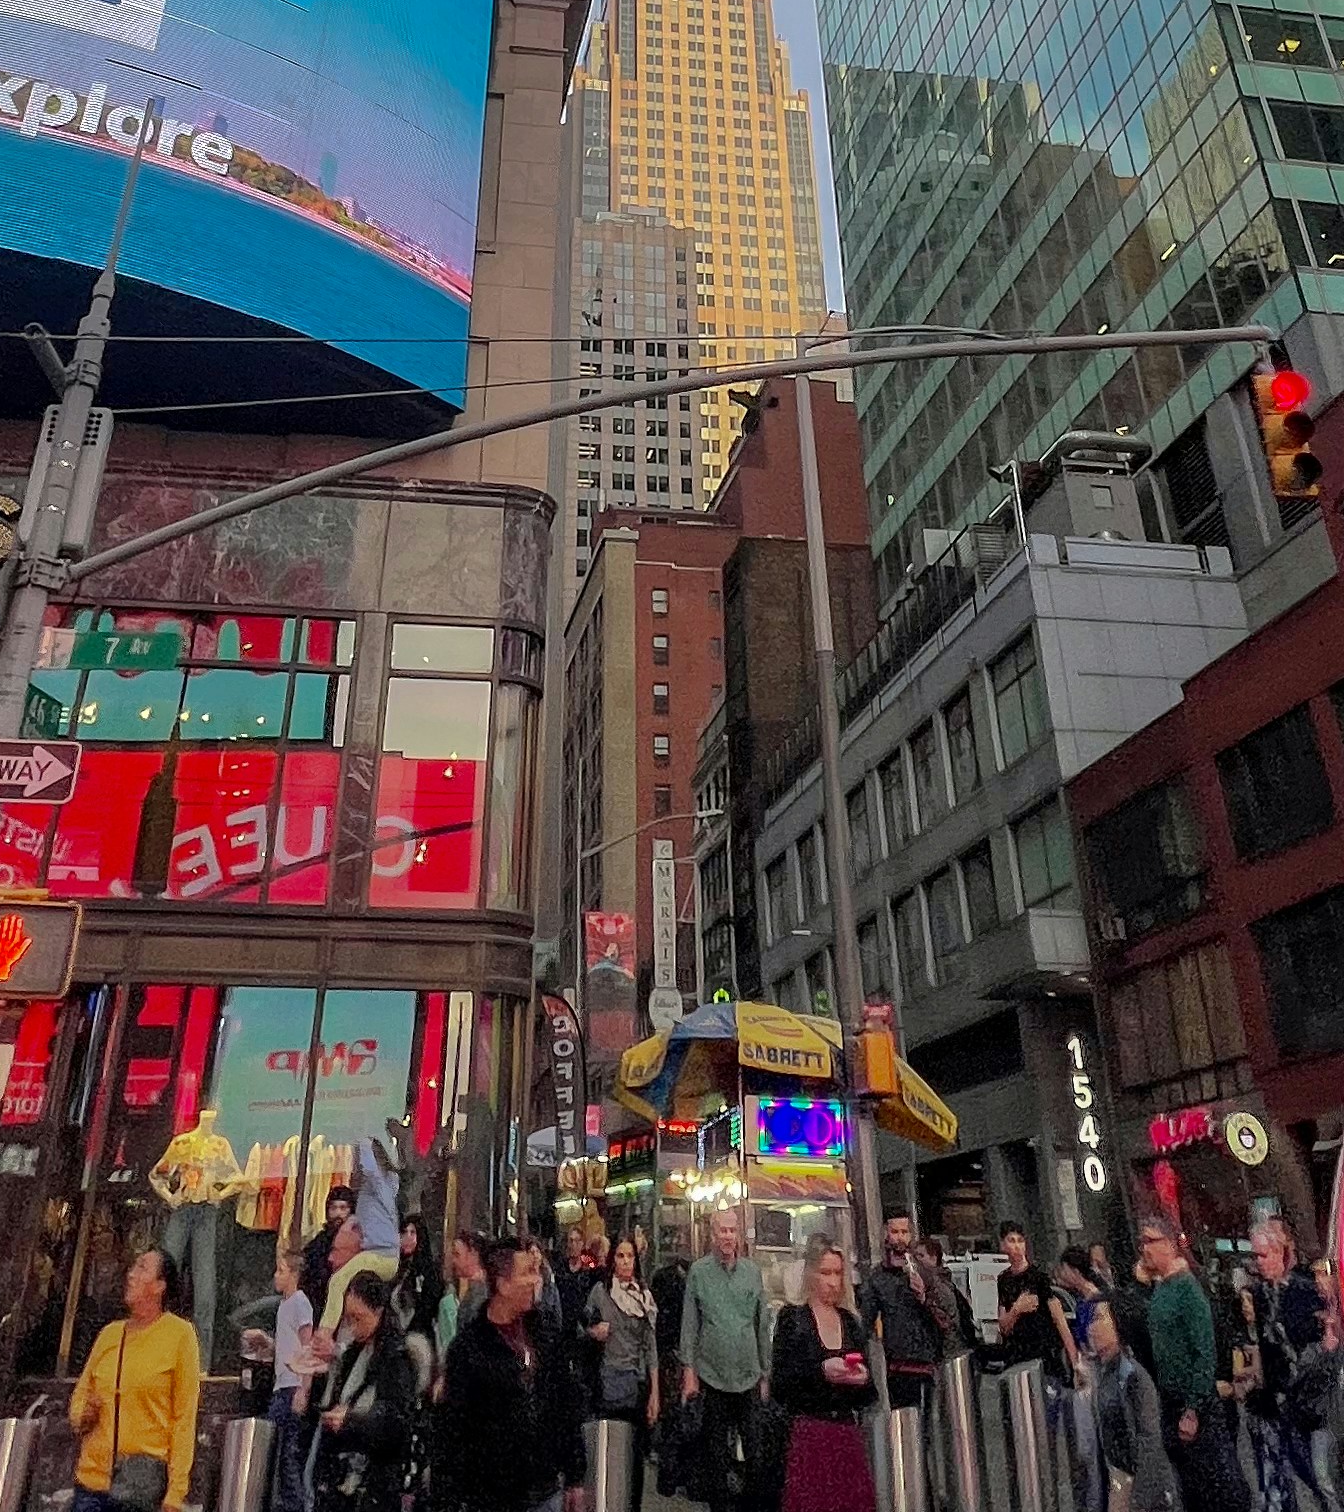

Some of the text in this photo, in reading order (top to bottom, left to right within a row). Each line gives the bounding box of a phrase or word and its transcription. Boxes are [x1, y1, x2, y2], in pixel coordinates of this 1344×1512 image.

[105, 638, 120, 664] 7
[657, 866, 672, 983] MARAIS
[742, 1042, 824, 1069] SABRETT
[1067, 1038, 1106, 1192] 1540
